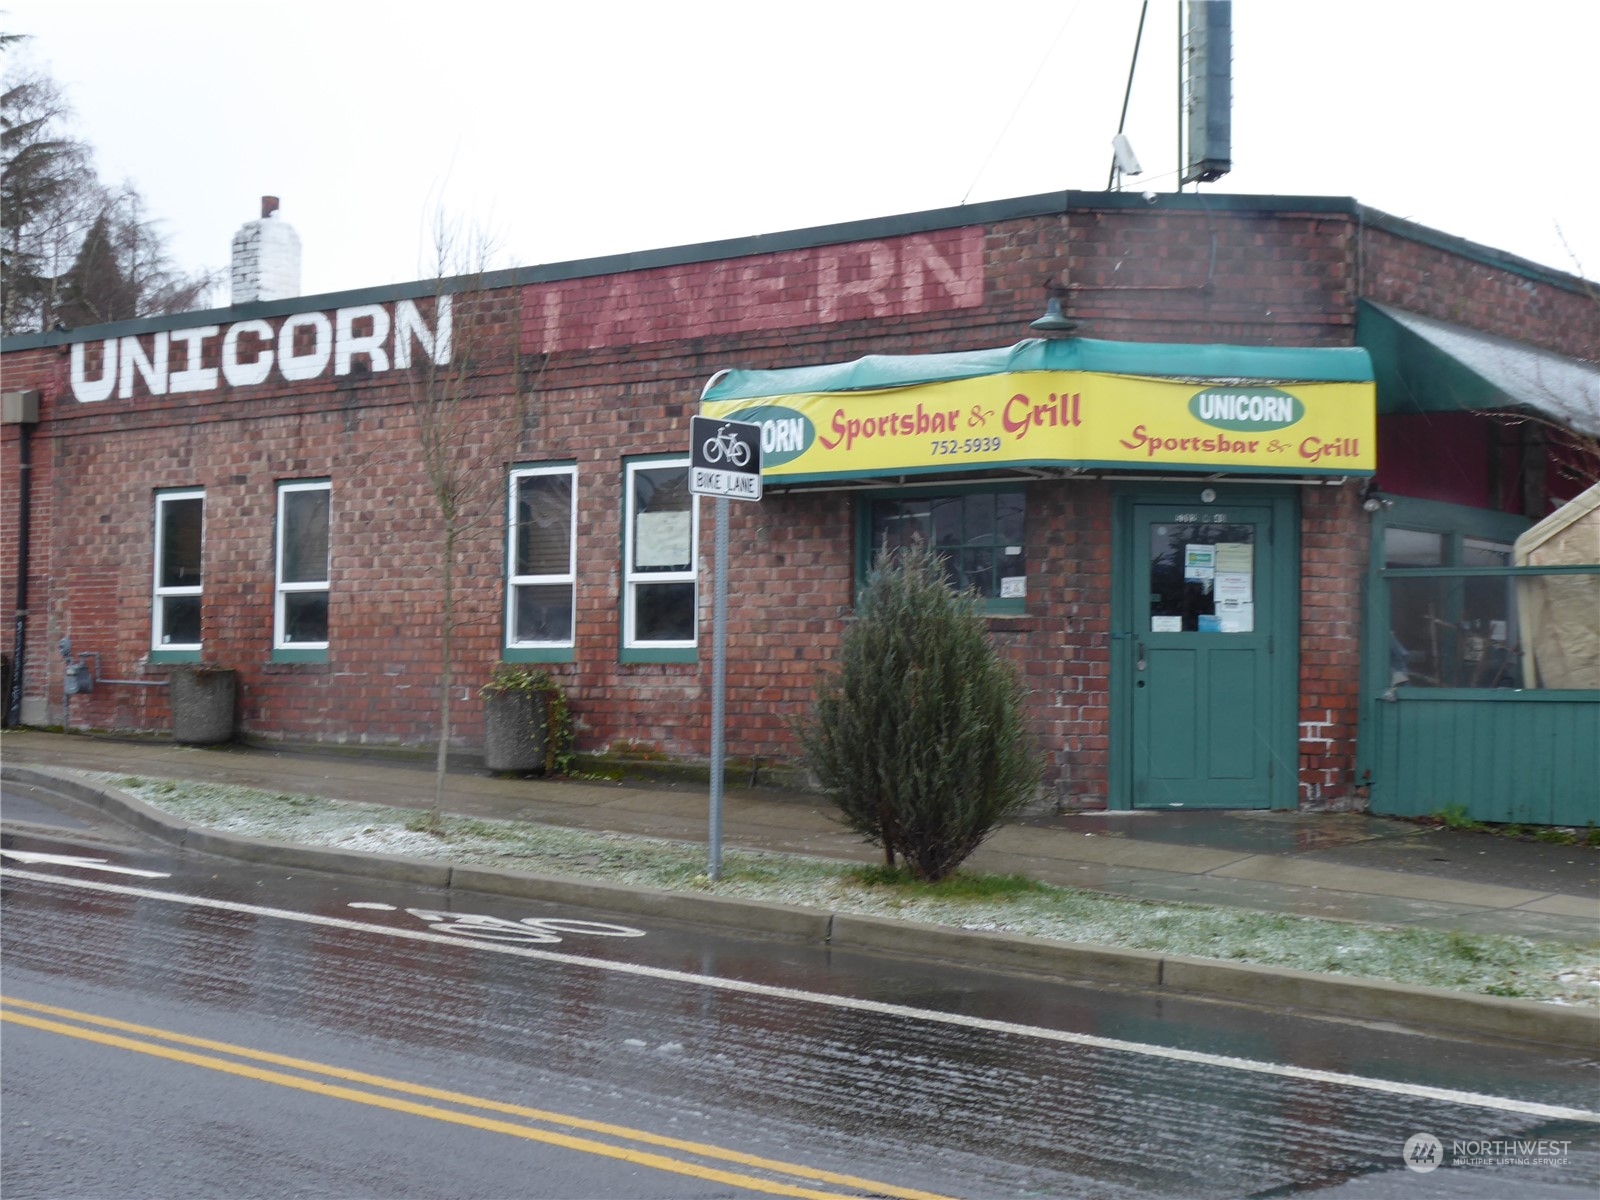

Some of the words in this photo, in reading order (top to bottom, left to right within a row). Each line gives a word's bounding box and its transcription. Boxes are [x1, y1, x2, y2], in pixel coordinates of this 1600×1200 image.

[70, 294, 453, 403] UNICORN
[757, 417, 804, 453] ORN
[819, 403, 960, 451] Sportsbar
[968, 404, 995, 428] &
[1002, 392, 1081, 440] Grill
[1200, 394, 1293, 422] UNICORN
[931, 436, 1001, 455] 752-5939
[1119, 425, 1259, 456] Sportsbar
[1267, 439, 1292, 453] &
[1299, 436, 1360, 463] Grill
[696, 472, 721, 490] BIKE
[727, 475, 755, 494] LANE
